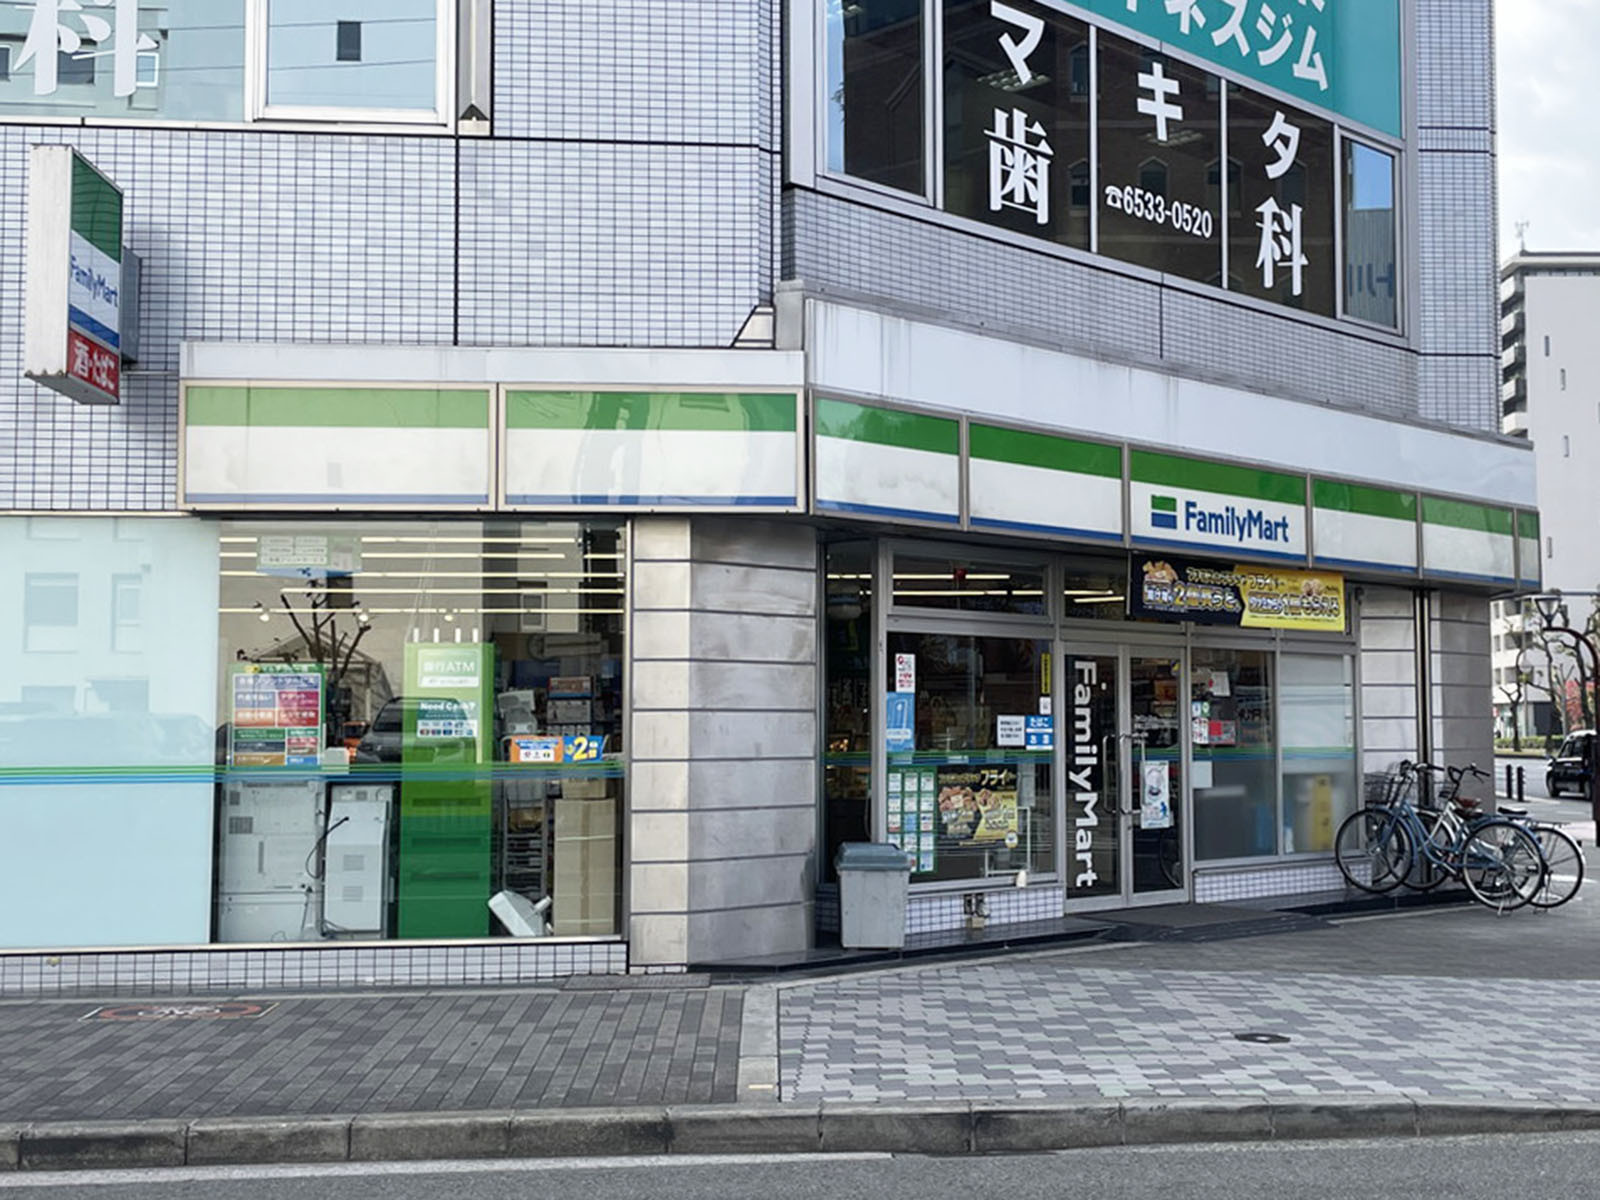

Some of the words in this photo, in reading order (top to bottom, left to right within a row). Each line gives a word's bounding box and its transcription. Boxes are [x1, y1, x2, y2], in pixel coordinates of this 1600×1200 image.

[1126, 0, 1328, 92] ネスジム
[1122, 184, 1213, 239] 6533-0520
[70, 255, 119, 308] FamilyMart
[1184, 500, 1289, 543] FamilyMart
[1068, 660, 1099, 888] FamilyMart
